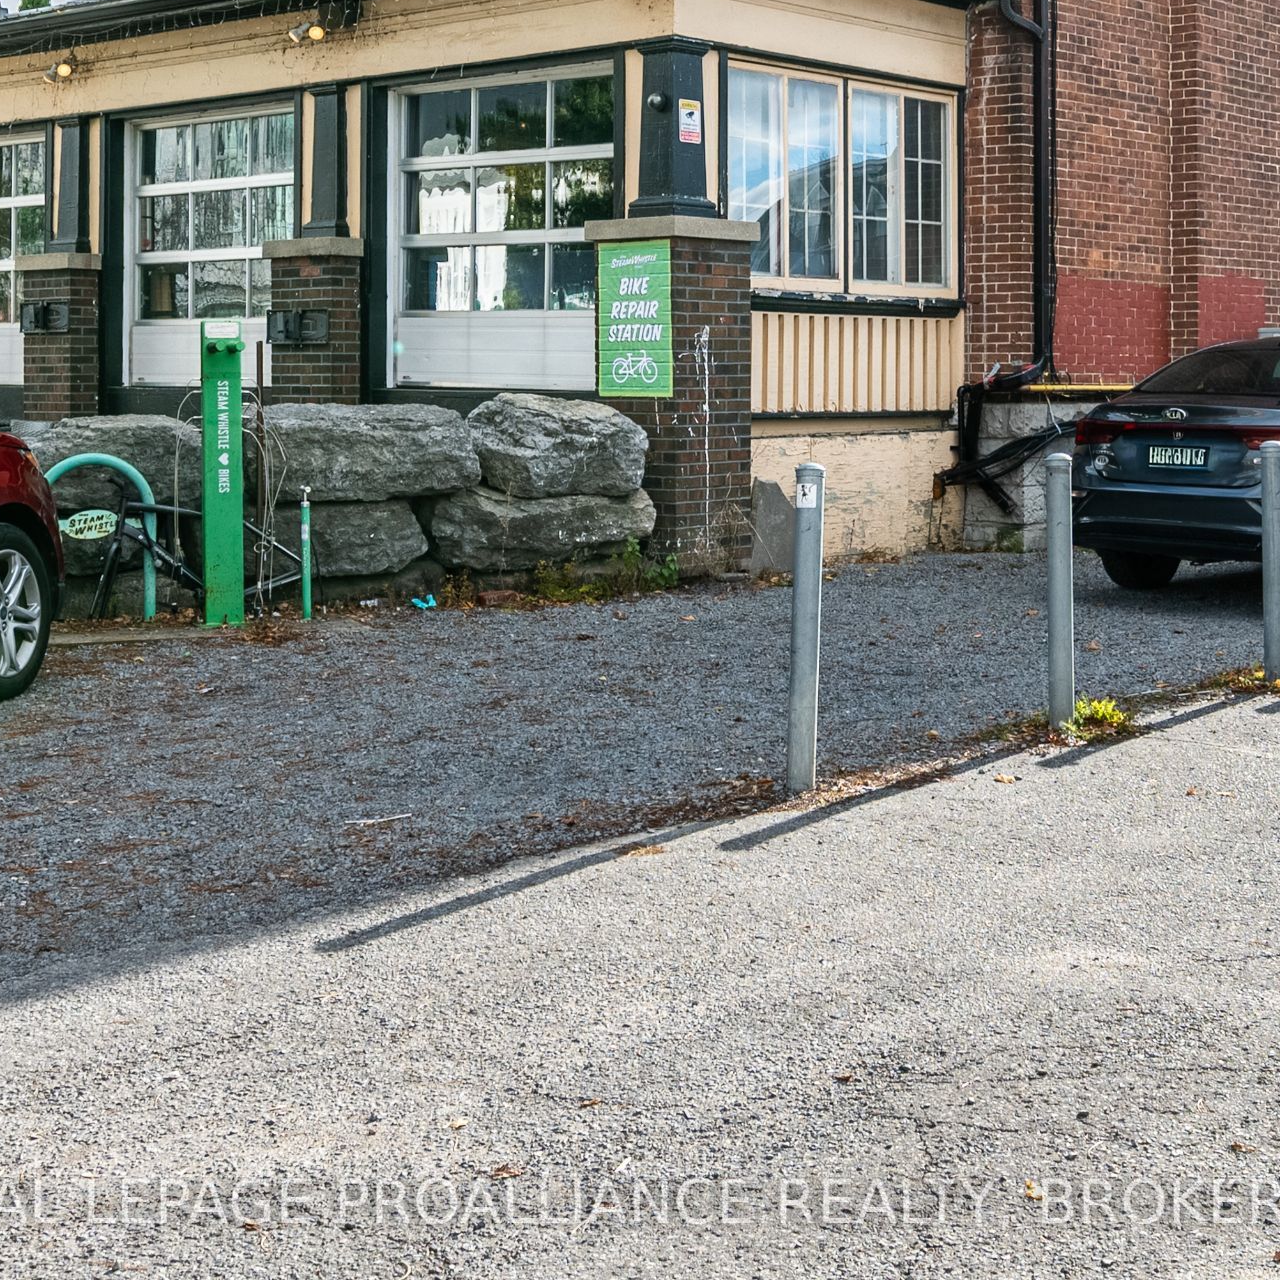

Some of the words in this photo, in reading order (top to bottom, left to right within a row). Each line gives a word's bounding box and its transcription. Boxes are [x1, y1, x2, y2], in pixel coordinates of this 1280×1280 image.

[619, 277, 649, 295] BIKE
[610, 300, 659, 319] REPAIR
[608, 323, 662, 342] STATION
[217, 380, 229, 410] STEAM
[217, 412, 229, 449] WHISTLE
[218, 469, 230, 493] BIKES
[69, 514, 105, 528] STEAM
[75, 521, 114, 535] WHISTL
